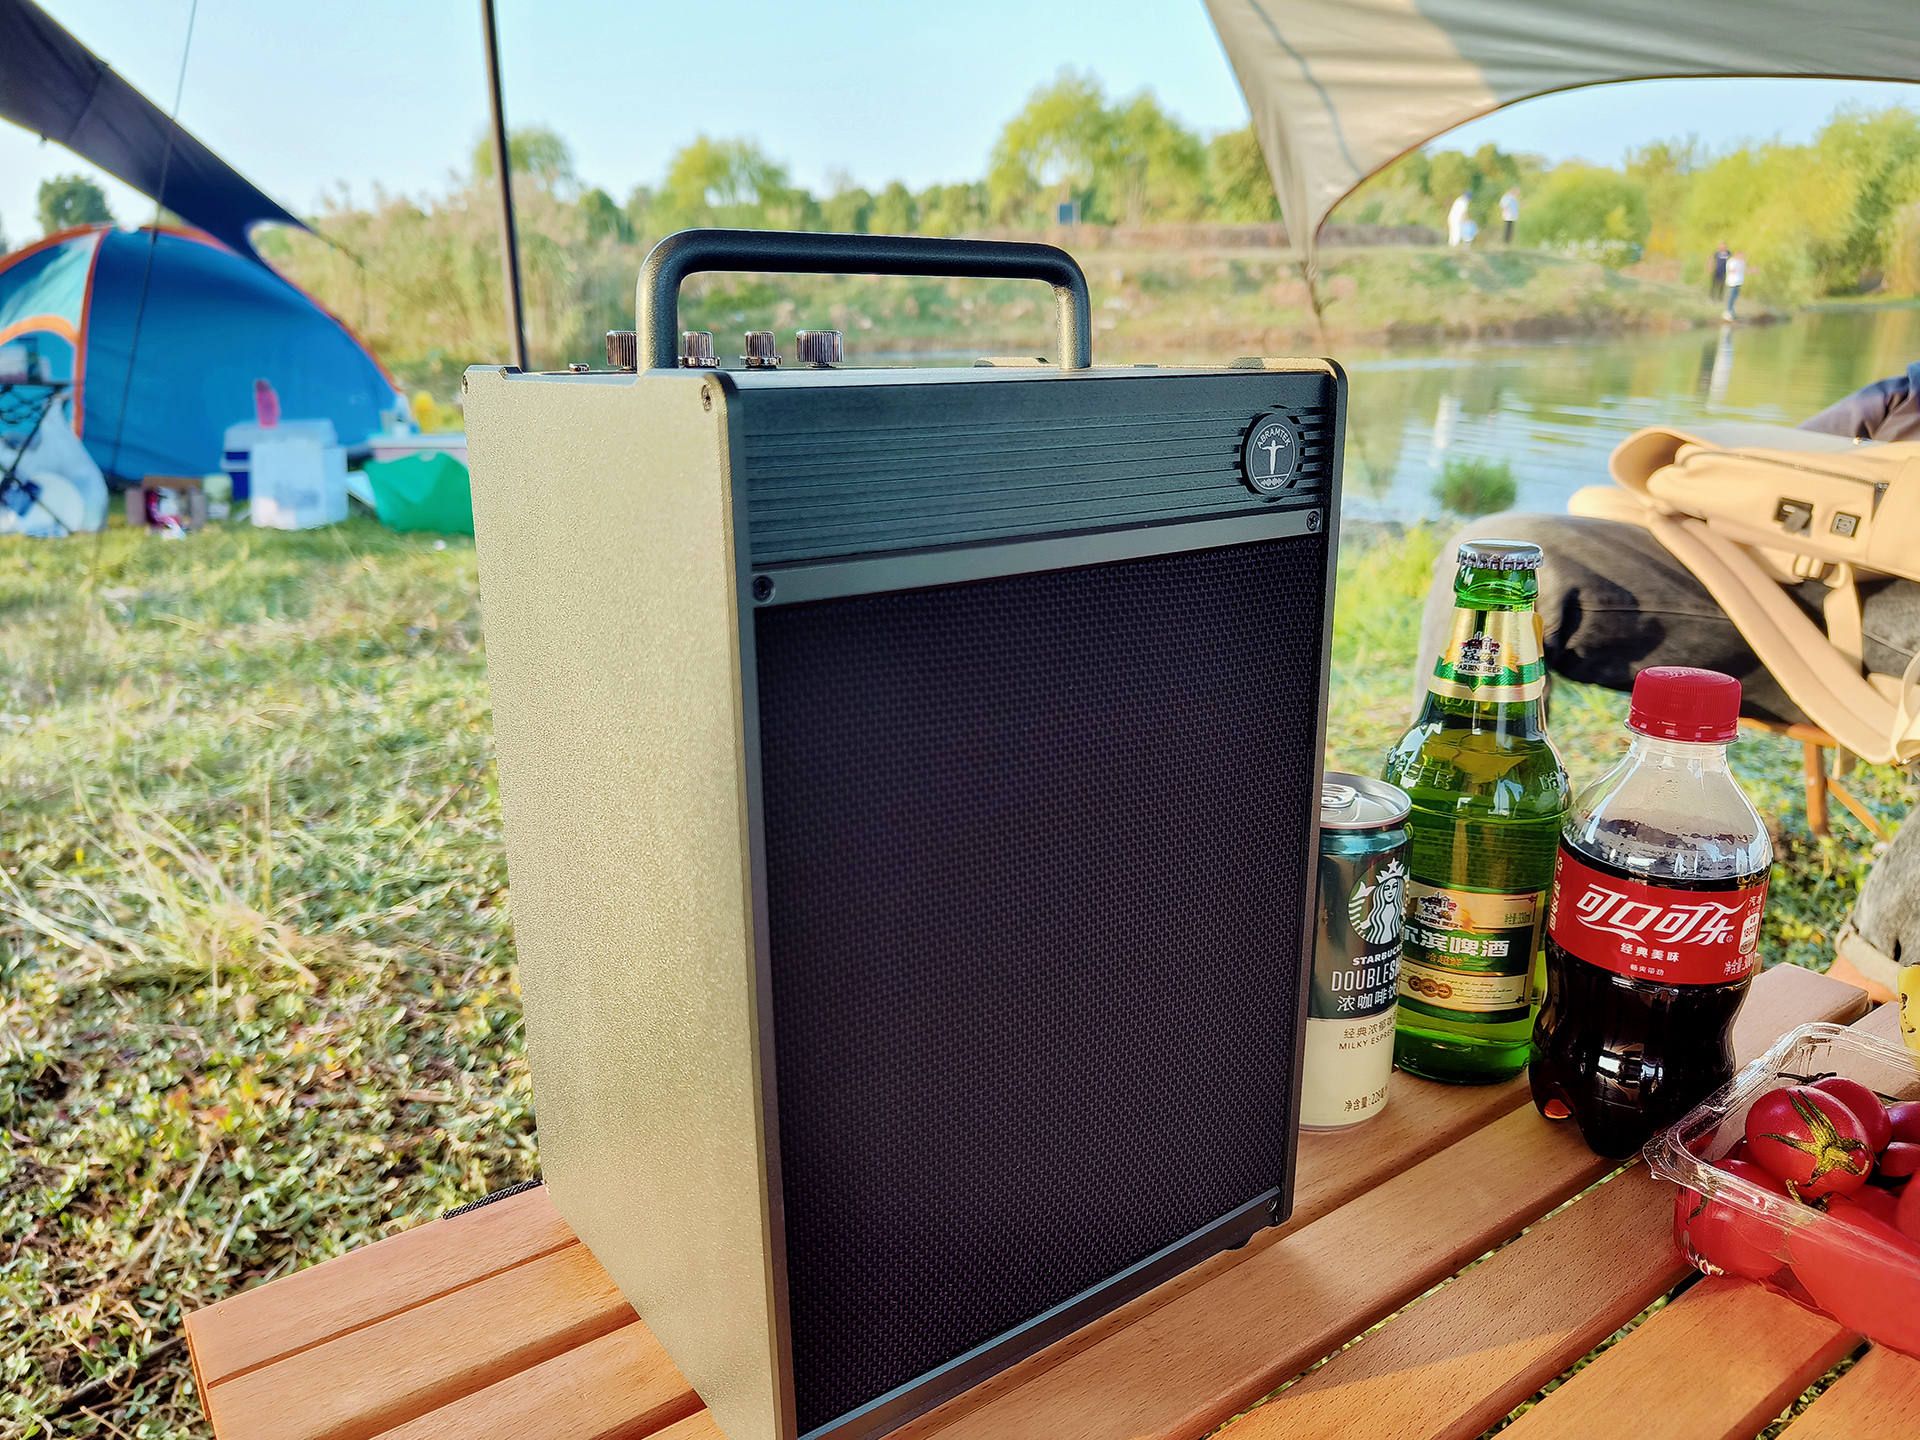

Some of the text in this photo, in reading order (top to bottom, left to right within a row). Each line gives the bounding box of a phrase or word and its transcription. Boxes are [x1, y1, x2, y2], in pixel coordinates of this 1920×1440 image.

[1257, 427, 1291, 449] ABRAMTEK
[1576, 883, 1747, 946] 可口可乐
[1352, 943, 1402, 966] STARBUCK
[1620, 942, 1680, 963] 经典美味
[1337, 983, 1398, 1012] 浓咖啡饮
[1338, 1039, 1368, 1050] MILKY
